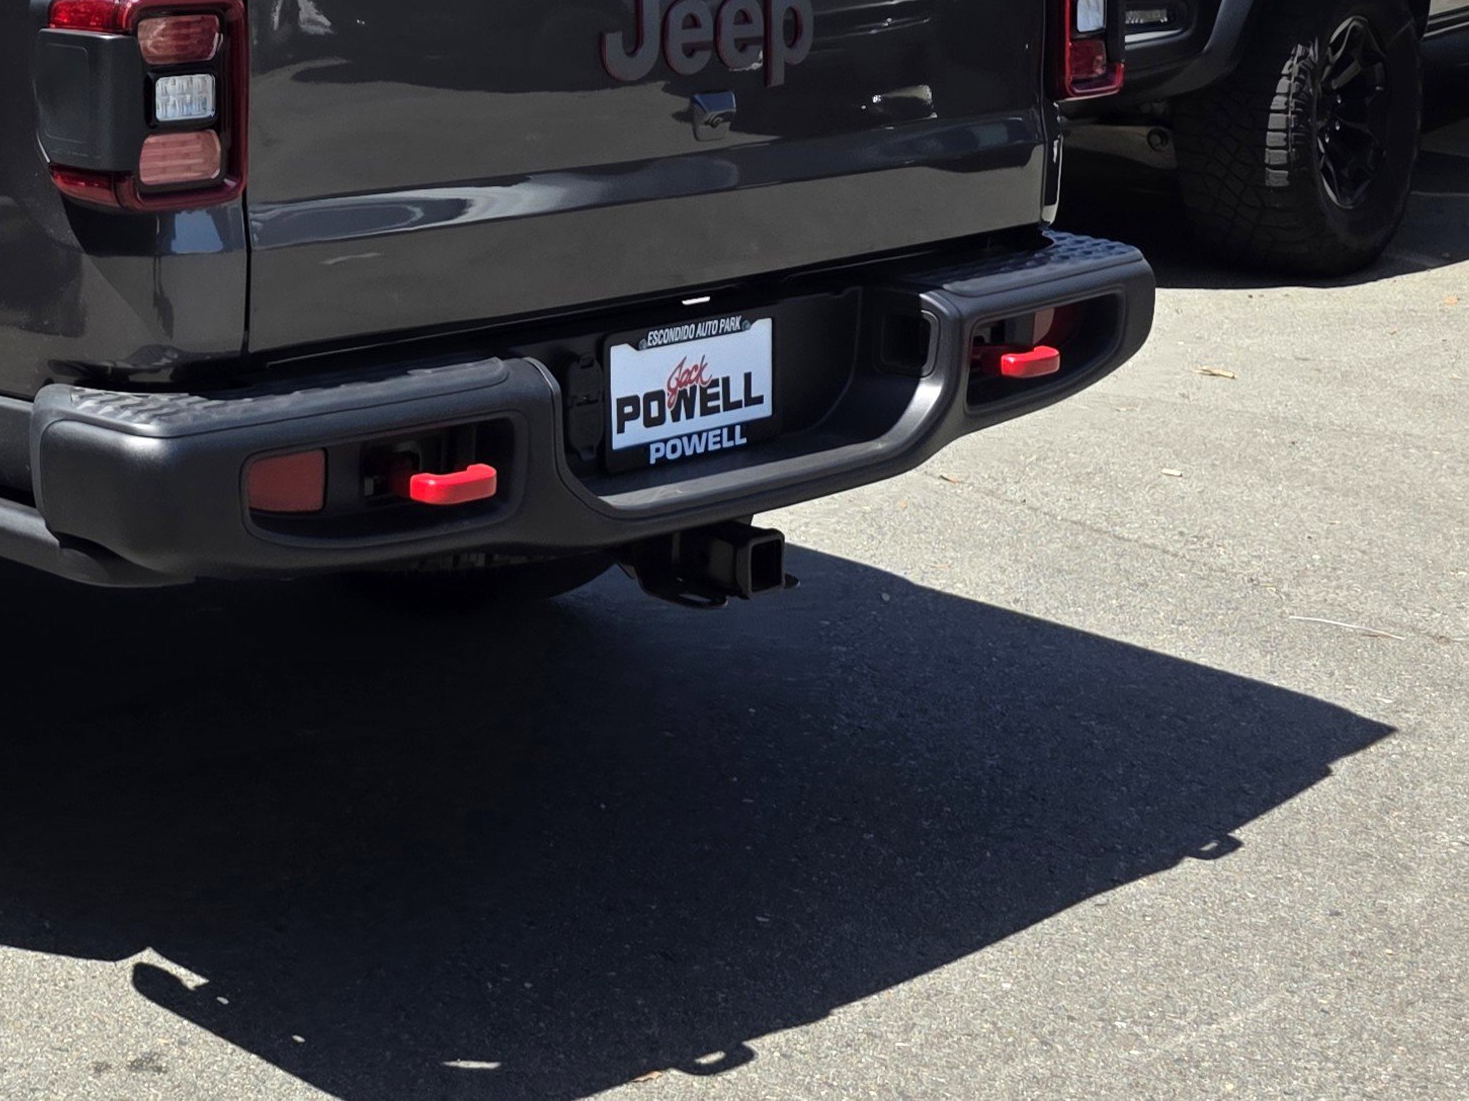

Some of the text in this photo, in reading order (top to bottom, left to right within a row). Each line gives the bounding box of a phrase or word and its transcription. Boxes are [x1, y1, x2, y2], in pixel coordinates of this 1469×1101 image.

[647, 315, 742, 346] ESCONDIDO AUTO PARK
[616, 371, 764, 434] POWELL
[666, 354, 712, 410] Jack
[650, 424, 747, 465] POWELL
